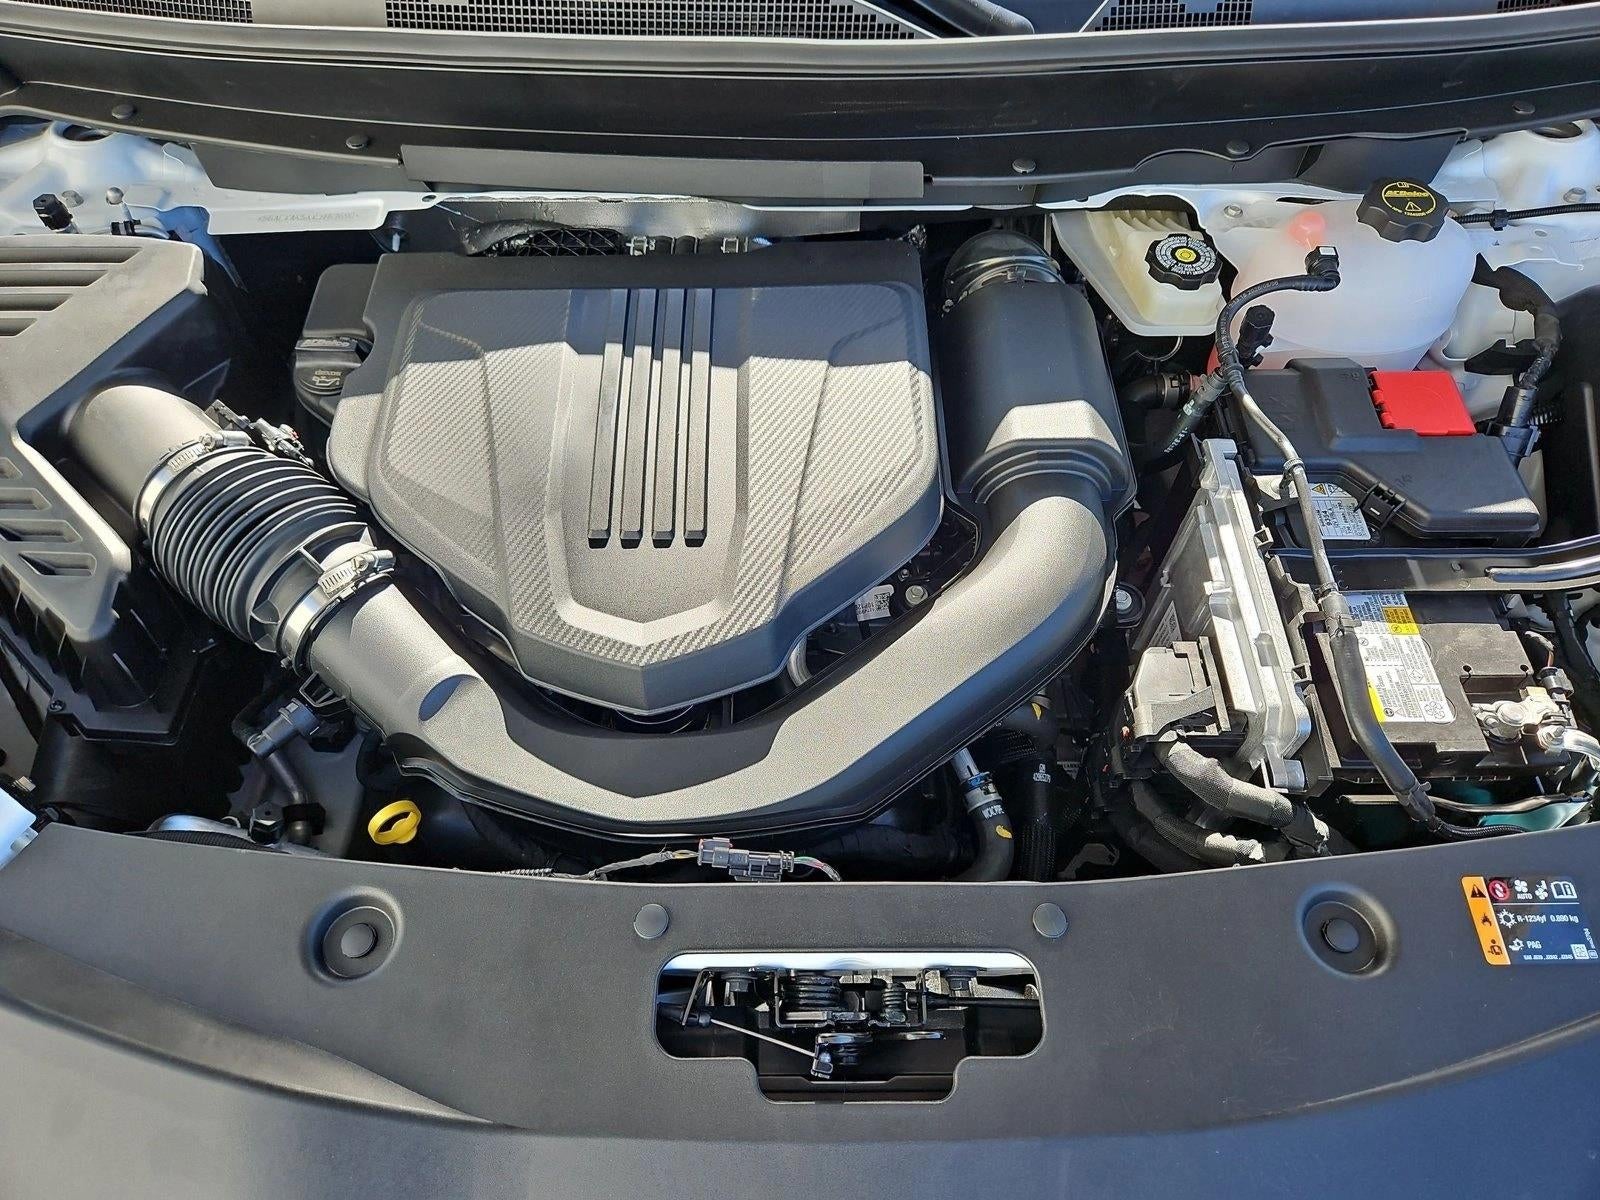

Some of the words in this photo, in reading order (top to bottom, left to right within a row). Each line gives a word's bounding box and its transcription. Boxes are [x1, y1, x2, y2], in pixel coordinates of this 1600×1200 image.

[1516, 914, 1547, 923] R-1234yf
[1569, 914, 1580, 923] kg
[1526, 940, 1542, 949] PAG
